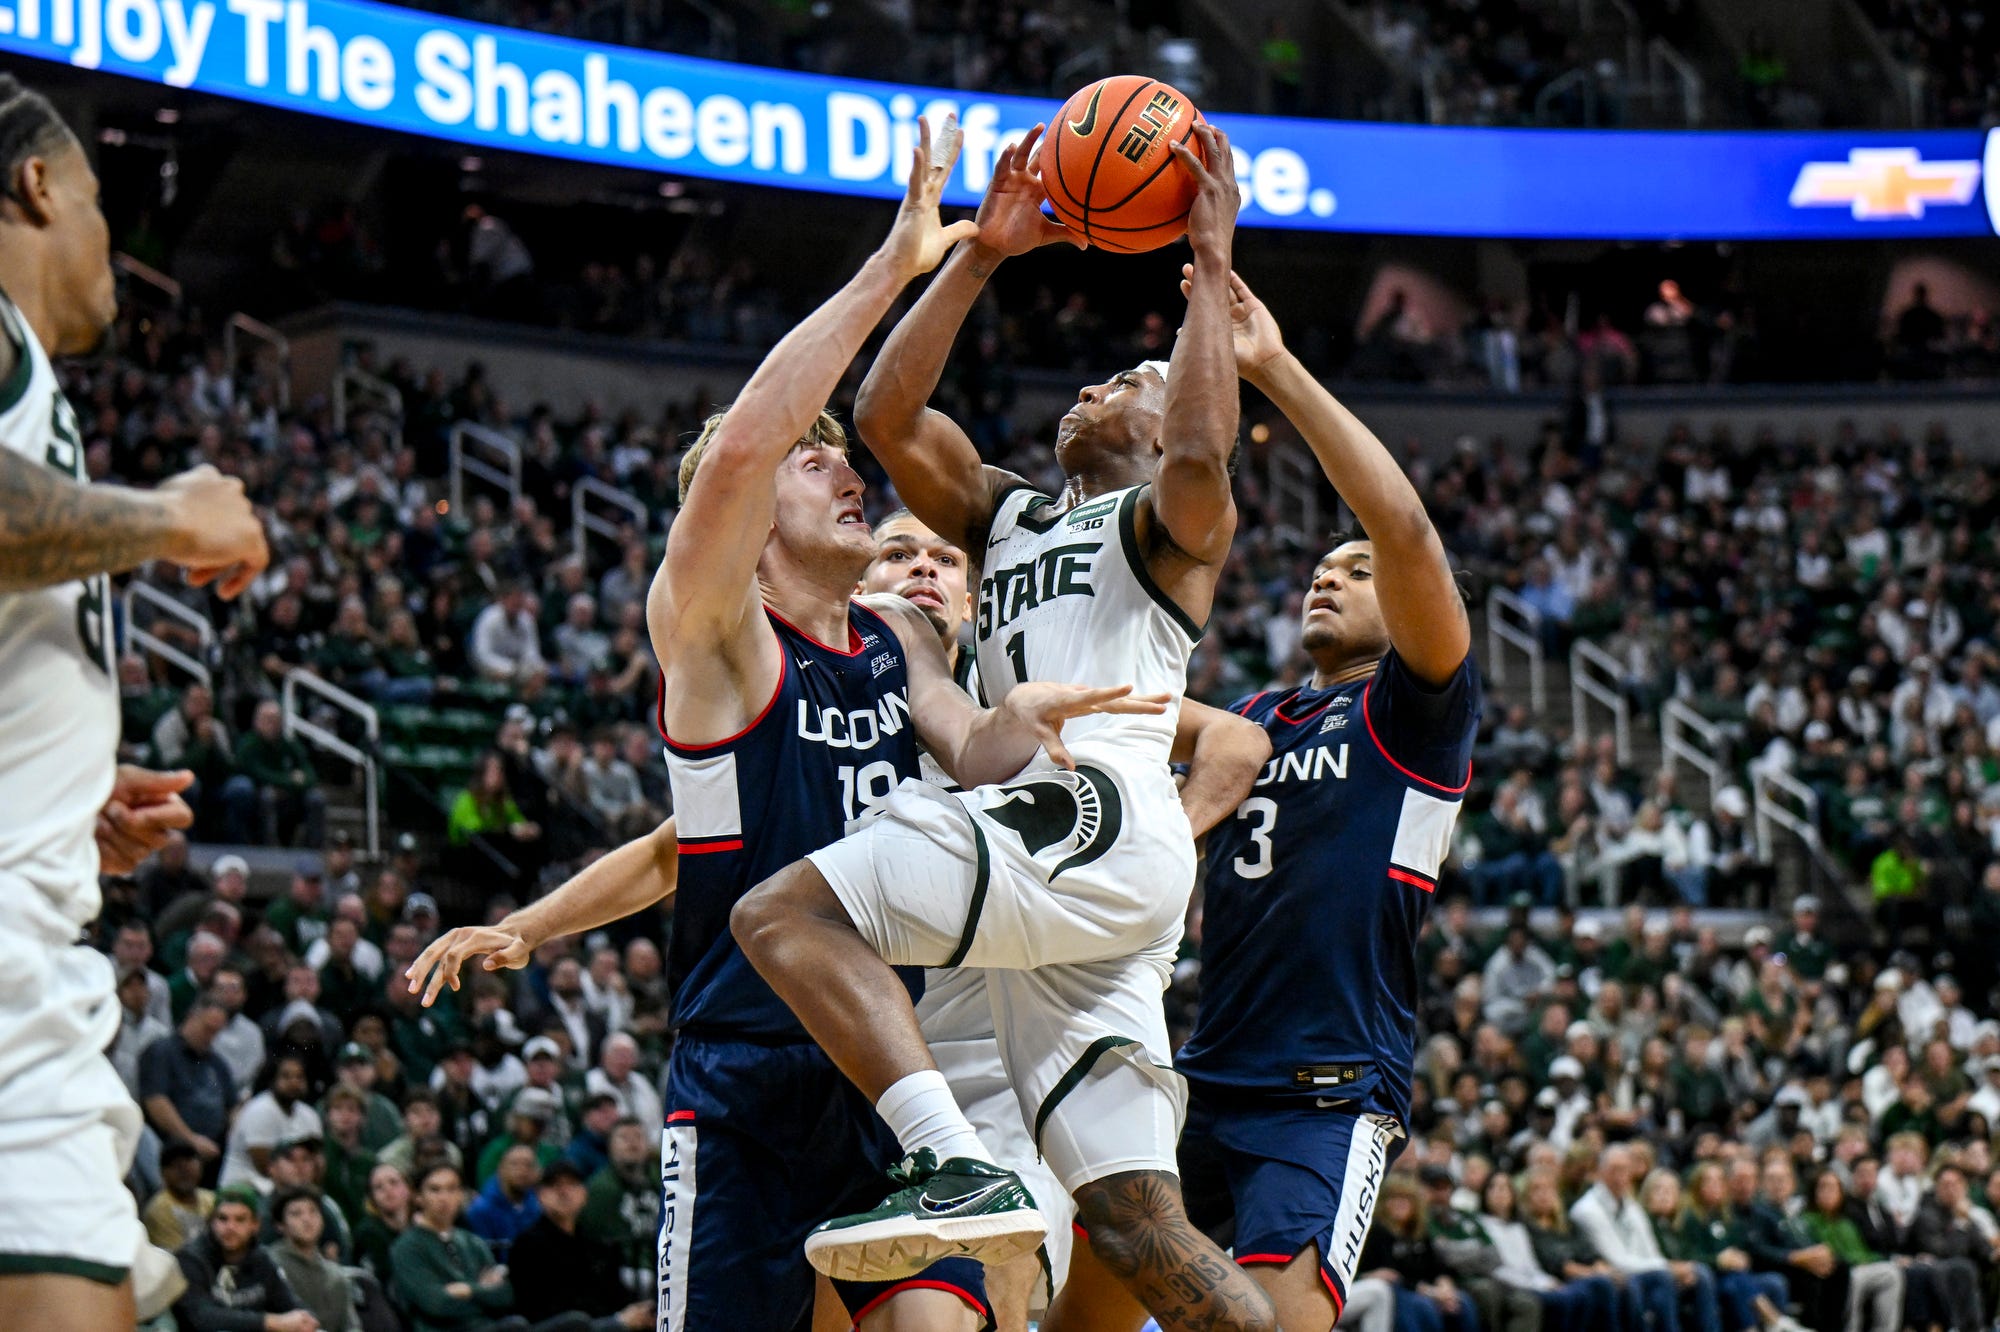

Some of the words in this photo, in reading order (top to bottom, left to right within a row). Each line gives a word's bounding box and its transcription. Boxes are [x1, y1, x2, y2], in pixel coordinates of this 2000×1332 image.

[0, 0, 216, 88] njoy
[228, 0, 396, 110] The
[414, 30, 807, 170] Shaheen
[827, 91, 1338, 218] Diffe.
[1117, 90, 1179, 164] ELITE
[978, 542, 1103, 642] STATE
[871, 652, 889, 667] BIG
[872, 656, 898, 675] EAST
[1006, 630, 1028, 683] 1
[797, 686, 911, 750] UCONN
[1234, 797, 1278, 879] 3
